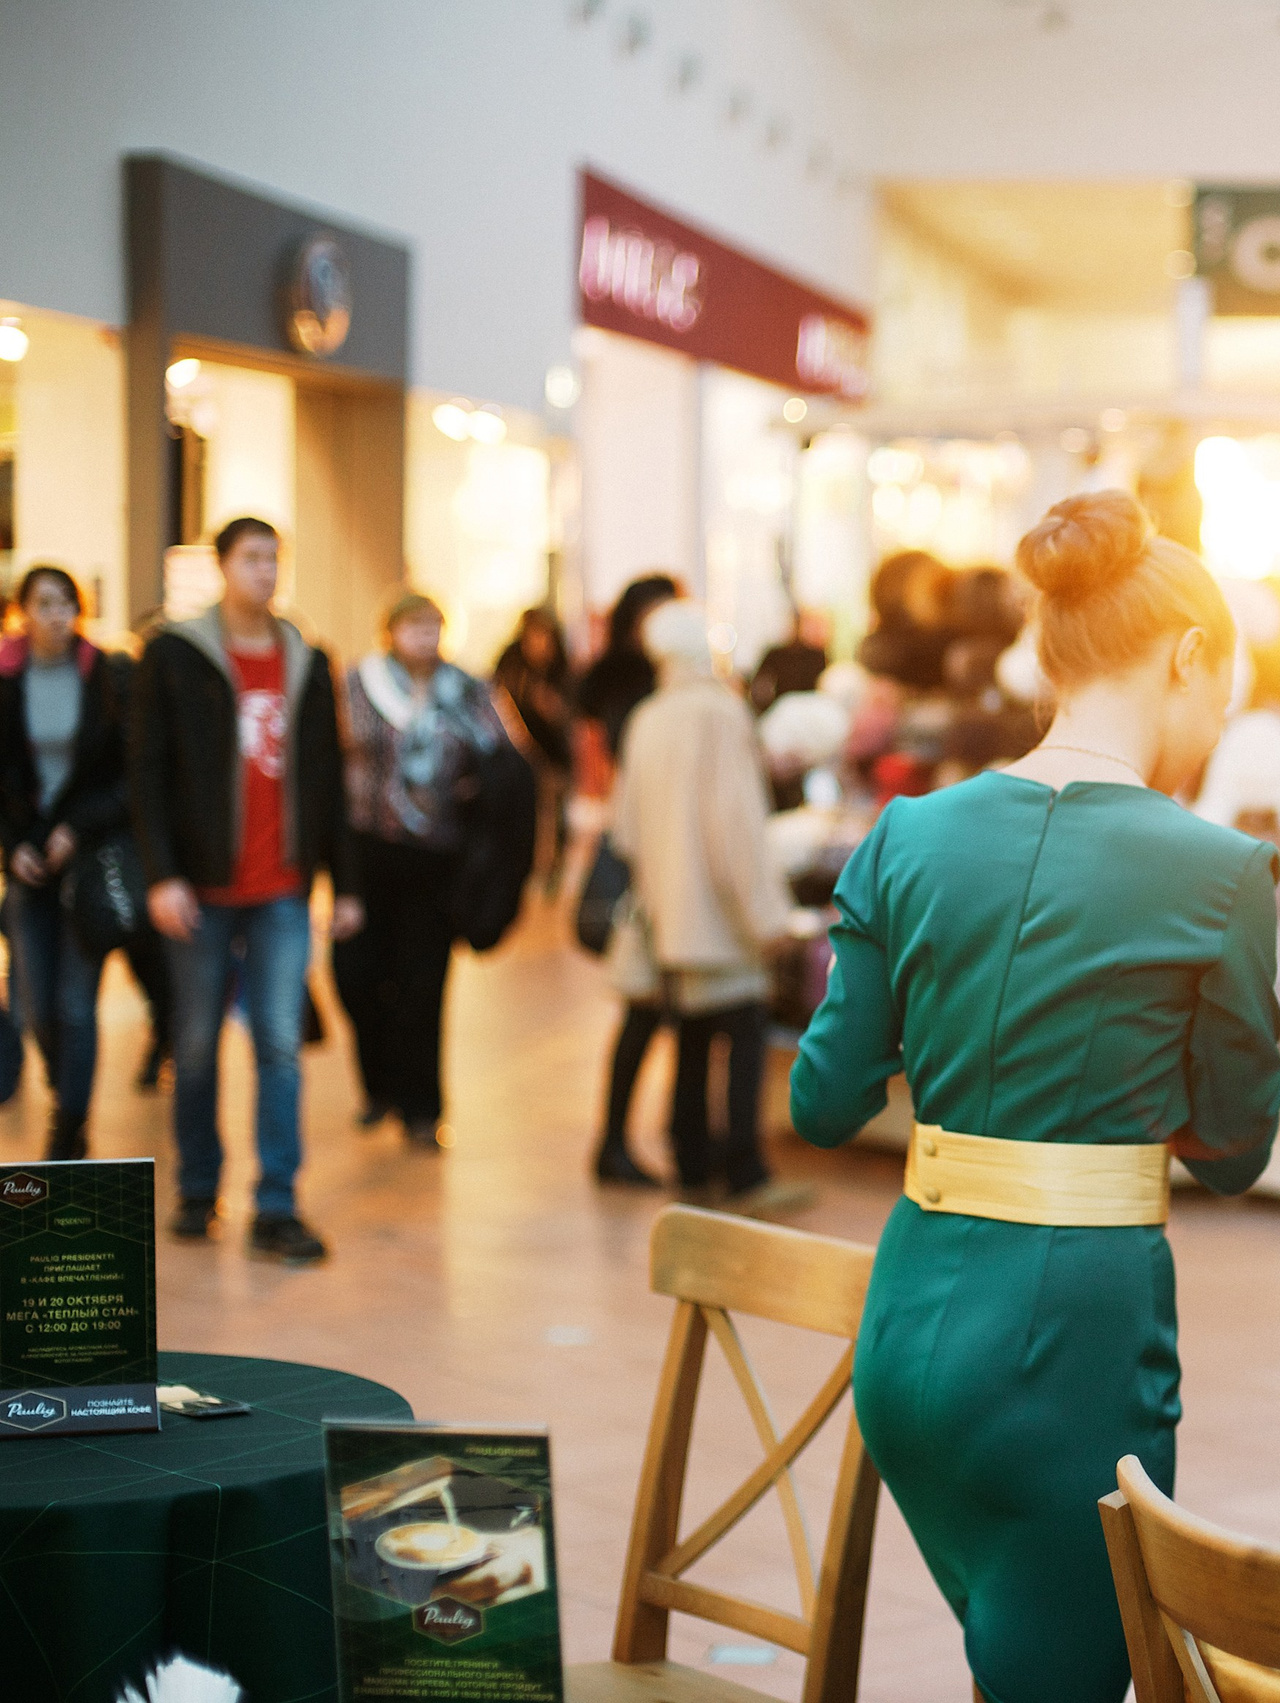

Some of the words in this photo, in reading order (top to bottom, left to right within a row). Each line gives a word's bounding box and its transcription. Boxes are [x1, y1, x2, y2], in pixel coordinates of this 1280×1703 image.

[3, 1181, 41, 1196] Paulig
[61, 1253, 115, 1261] PRESIDENTTI
[44, 1264, 101, 1272] ПРИГЛАШАЕТ
[22, 1298, 35, 1307] 19
[38, 1298, 47, 1307] И
[50, 1297, 63, 1306] 20
[67, 1295, 124, 1305] ОКТЯБРЯ
[6, 1311, 39, 1320] МЕГА
[25, 1324, 33, 1333] С
[38, 1323, 67, 1332] 12:00
[70, 1322, 88, 1332] ДО
[92, 1320, 121, 1330] 19:00
[87, 1398, 134, 1407] ПОЗНАЙТЕ
[7, 1402, 56, 1417] Paulig
[71, 1407, 126, 1416] НАСТОЯЩИЙ
[127, 1405, 152, 1413] КОФЕ
[424, 1607, 475, 1629] Paulig
[404, 1659, 451, 1668] ПОСЕТИТЕ
[380, 1668, 482, 1679] ПРОФЕССИОНАЛЬНОГО
[485, 1671, 525, 1680] БАРИСТА
